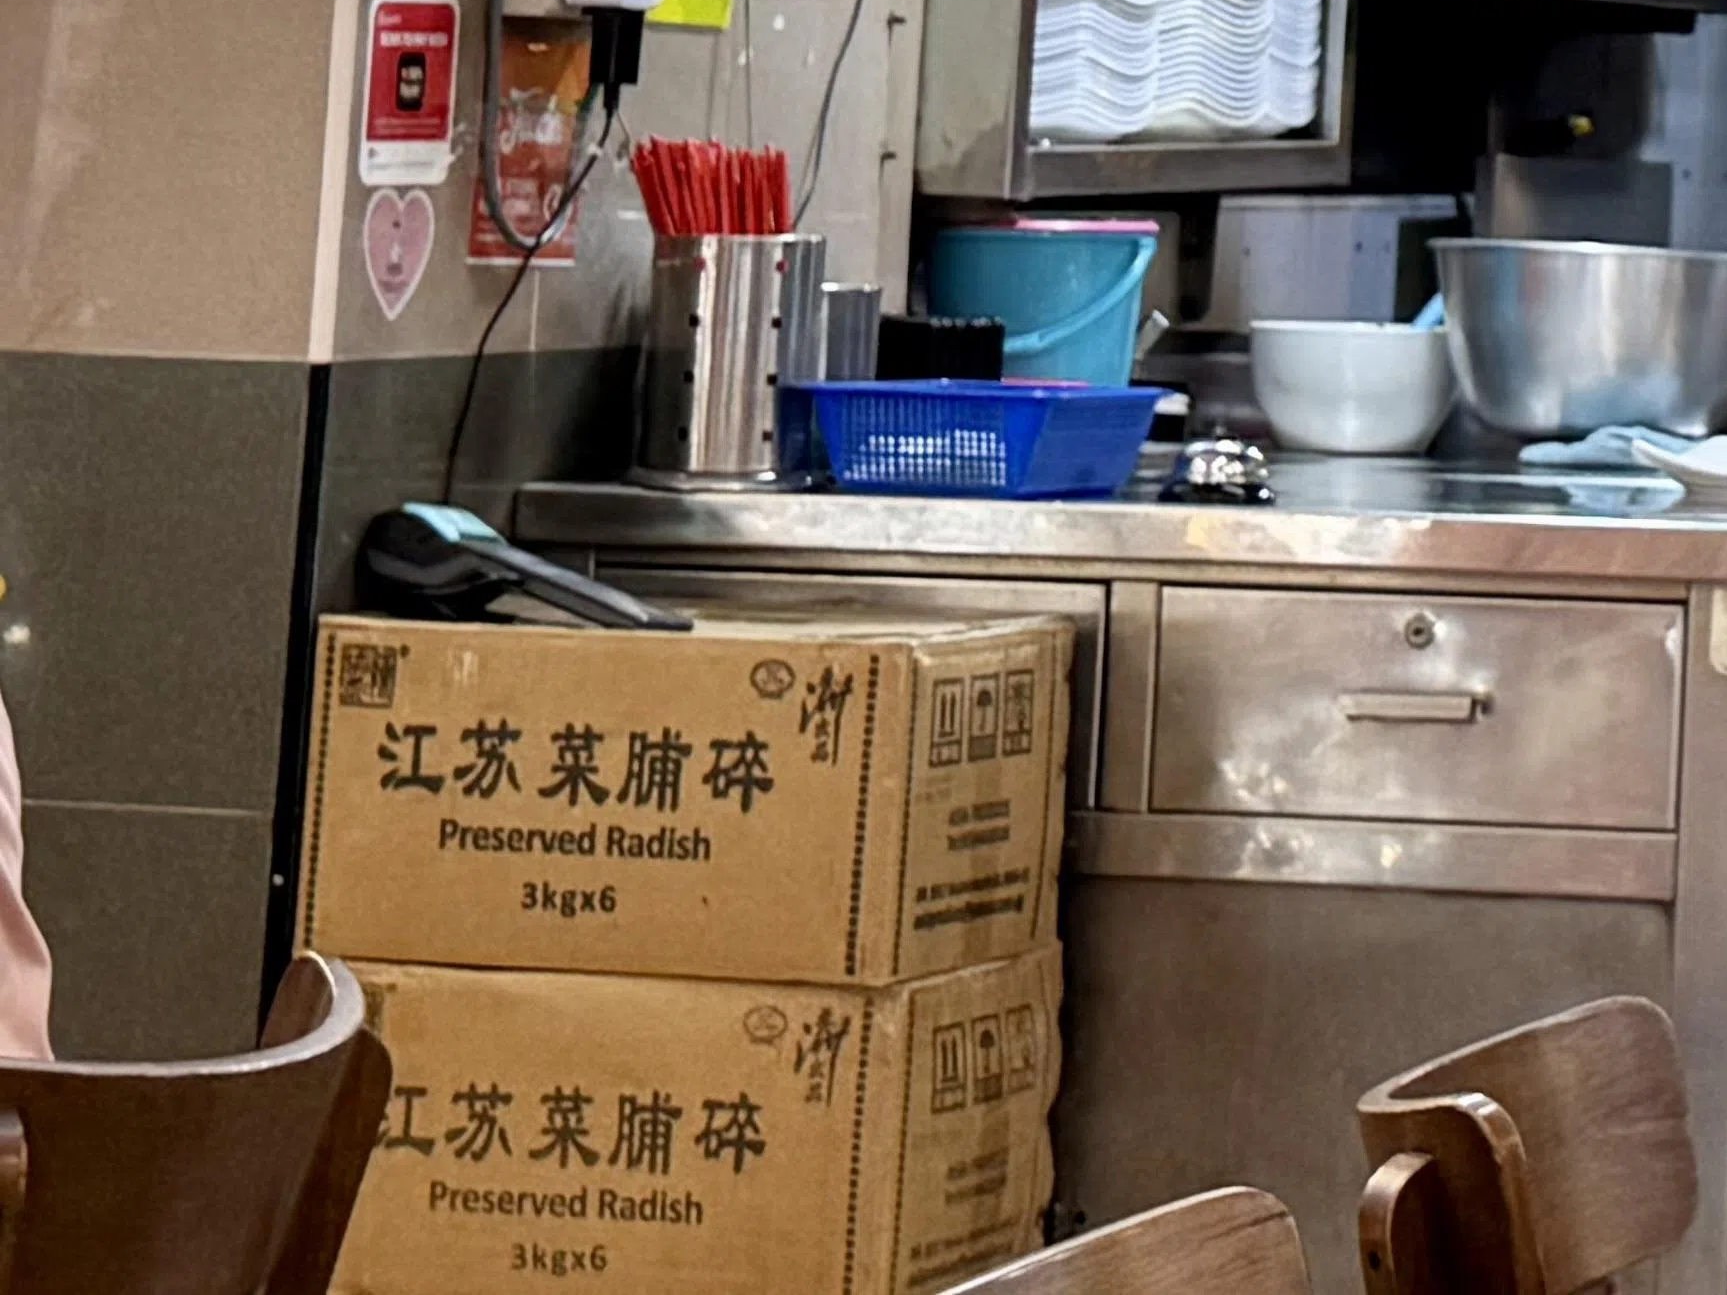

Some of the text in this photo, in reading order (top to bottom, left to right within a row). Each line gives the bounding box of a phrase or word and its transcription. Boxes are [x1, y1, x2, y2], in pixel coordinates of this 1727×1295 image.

[376, 720, 775, 813] 江苏菜脯碎
[439, 818, 711, 861] Preserved Radish
[520, 882, 616, 919] 3kgx6
[429, 1182, 703, 1225] Preserved Radish
[511, 1244, 608, 1280] 3kgx6
